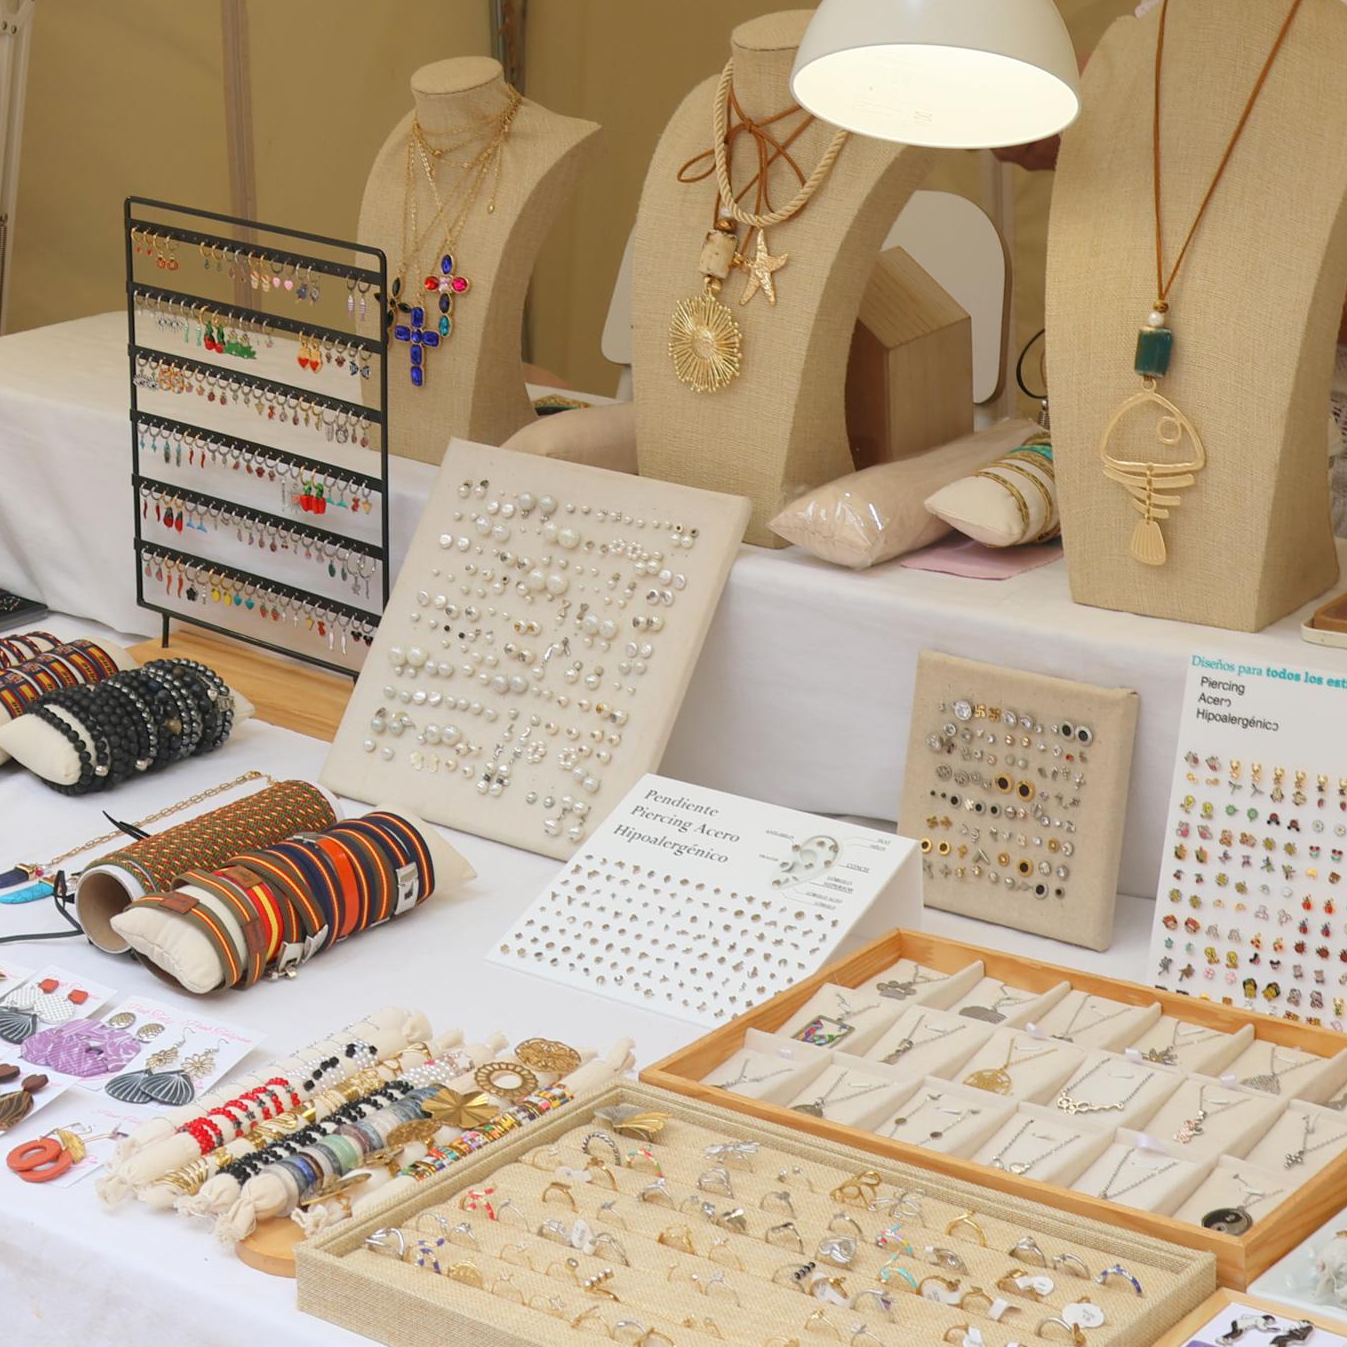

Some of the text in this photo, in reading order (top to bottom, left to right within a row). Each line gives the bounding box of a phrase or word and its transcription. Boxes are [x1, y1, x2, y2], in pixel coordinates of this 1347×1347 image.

[1191, 655, 1235, 673] Diseños
[1237, 664, 1263, 677] para
[1266, 667, 1301, 682] todos
[1304, 671, 1323, 684] los
[1200, 676, 1245, 695] Piercing
[644, 789, 719, 817] Pendiente
[630, 805, 692, 834] Piercing
[698, 823, 740, 843] Acero
[613, 824, 729, 864] Hipoalergénico
